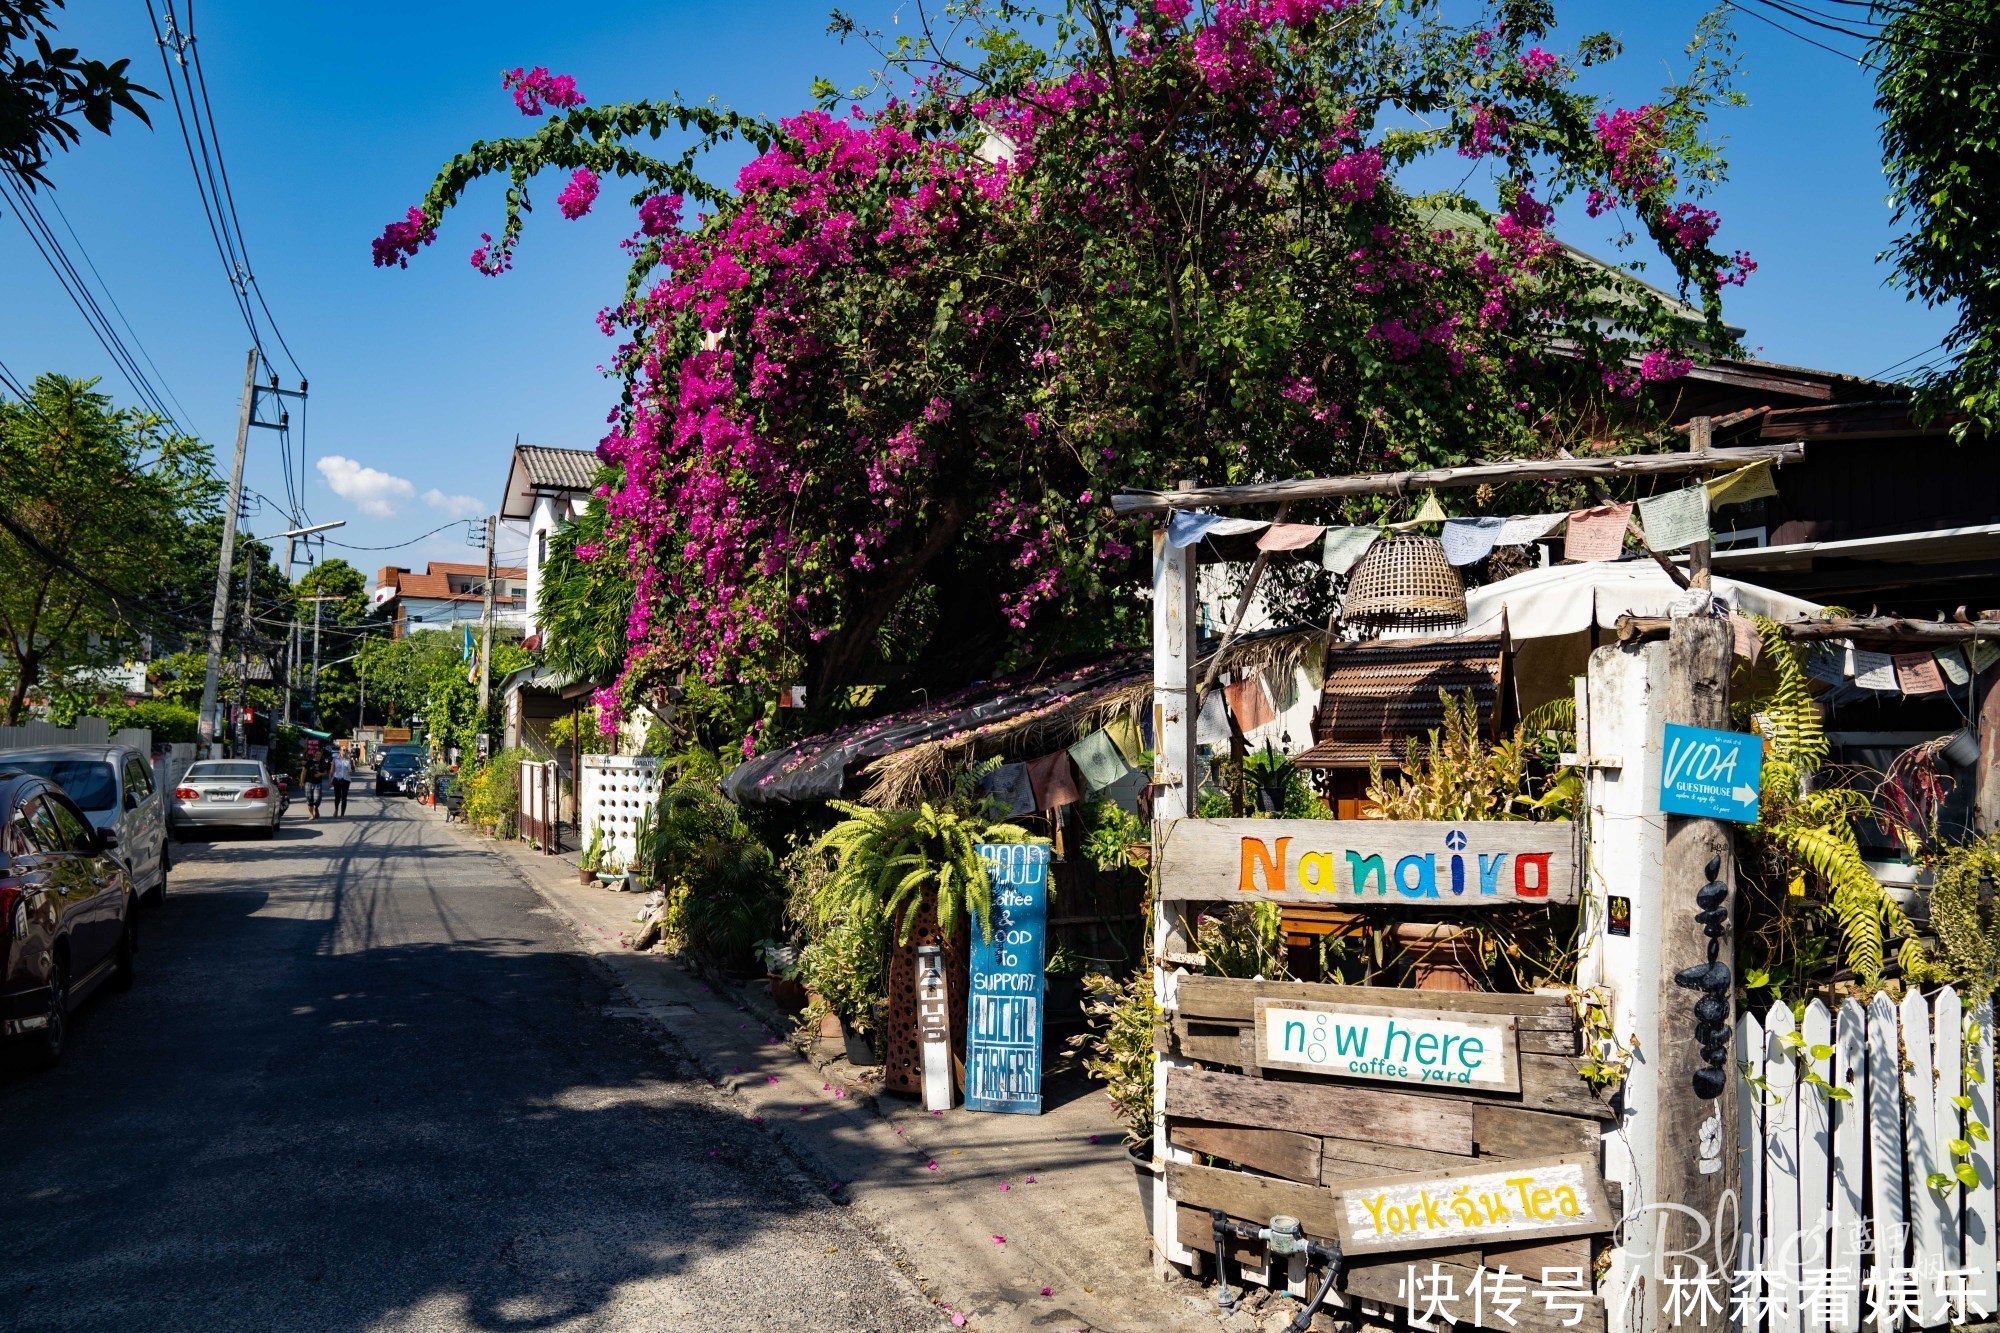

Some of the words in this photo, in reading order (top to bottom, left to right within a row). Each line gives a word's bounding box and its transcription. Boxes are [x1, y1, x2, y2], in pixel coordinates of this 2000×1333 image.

[1664, 737, 1738, 788] VIDA
[1676, 781, 1731, 797] GUESTHOUSE
[1238, 830, 1554, 899] Nanairo
[999, 909, 1016, 927] &
[995, 930, 1032, 945] OOD
[973, 972, 1037, 992] SUPPORT
[974, 995, 1036, 1043] LOCAL
[972, 1045, 1038, 1102] FARMERS
[1349, 1057, 1408, 1078] coffee
[1421, 1068, 1471, 1084] yard
[1361, 1190, 1447, 1234] York
[1505, 1177, 1581, 1220] Tea
